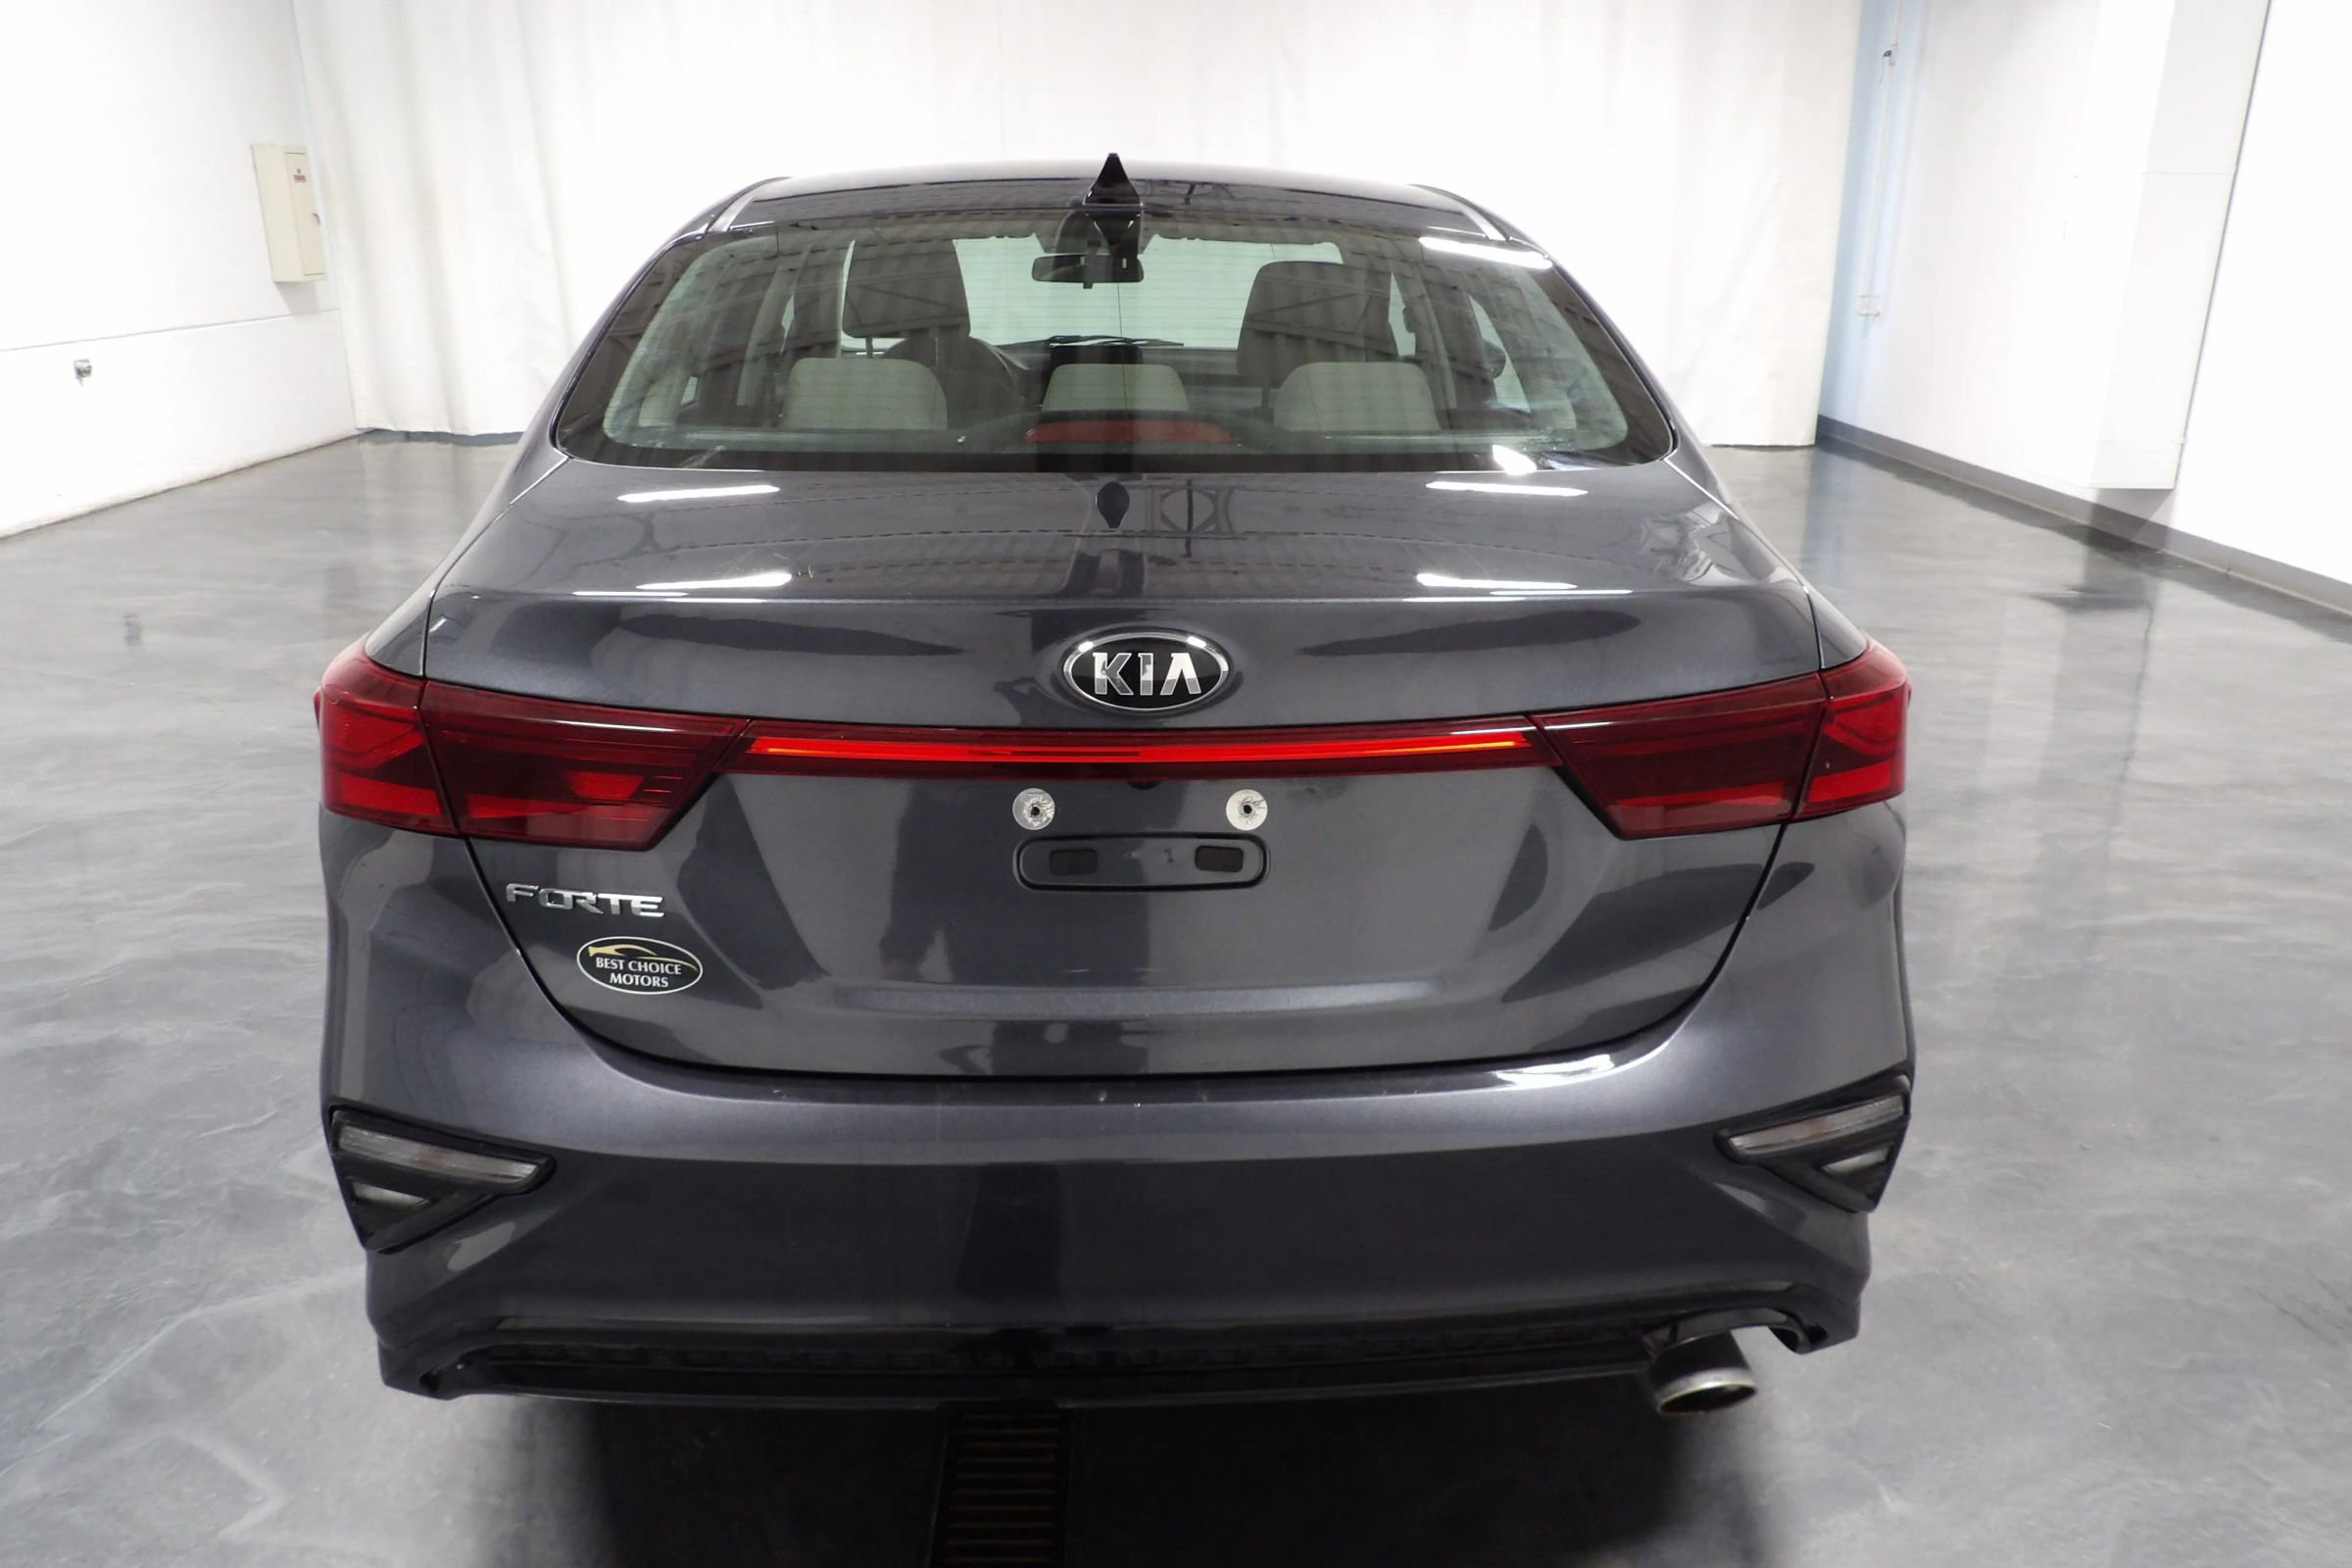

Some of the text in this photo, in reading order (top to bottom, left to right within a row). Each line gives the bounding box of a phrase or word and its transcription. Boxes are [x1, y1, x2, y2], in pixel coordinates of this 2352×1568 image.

[1092, 652, 1201, 696] KIA
[506, 883, 665, 918] FORTE
[595, 956, 682, 975] BEST CHOICE
[610, 973, 668, 988] MOTORS
